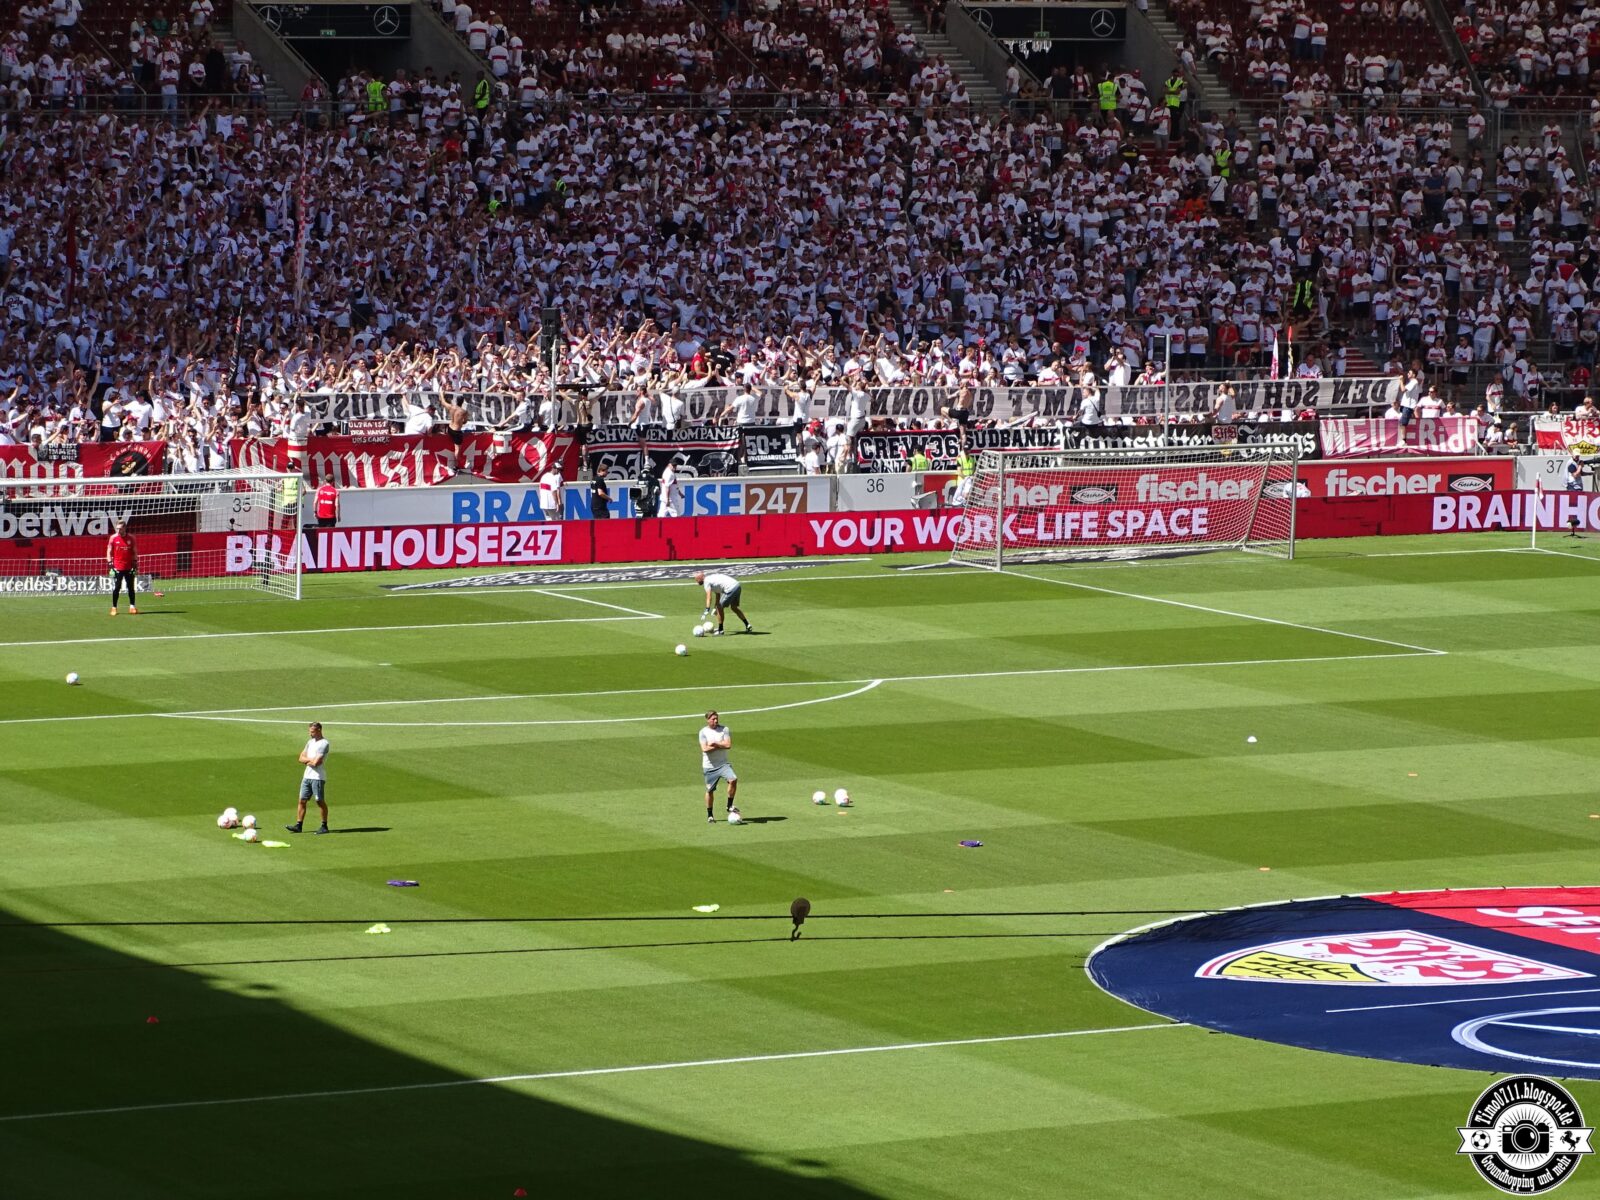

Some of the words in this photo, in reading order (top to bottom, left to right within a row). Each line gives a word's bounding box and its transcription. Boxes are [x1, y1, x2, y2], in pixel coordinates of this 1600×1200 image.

[745, 434, 796, 455] 50+1
[518, 437, 574, 483] 97
[1546, 460, 1564, 474] 37
[866, 478, 885, 493] 36
[943, 476, 1064, 508] fcher
[1136, 473, 1254, 504] fischer
[1326, 467, 1442, 497] fischer
[232, 497, 251, 513] 35
[810, 518, 905, 549] YOUR
[1107, 507, 1209, 538] SPACE
